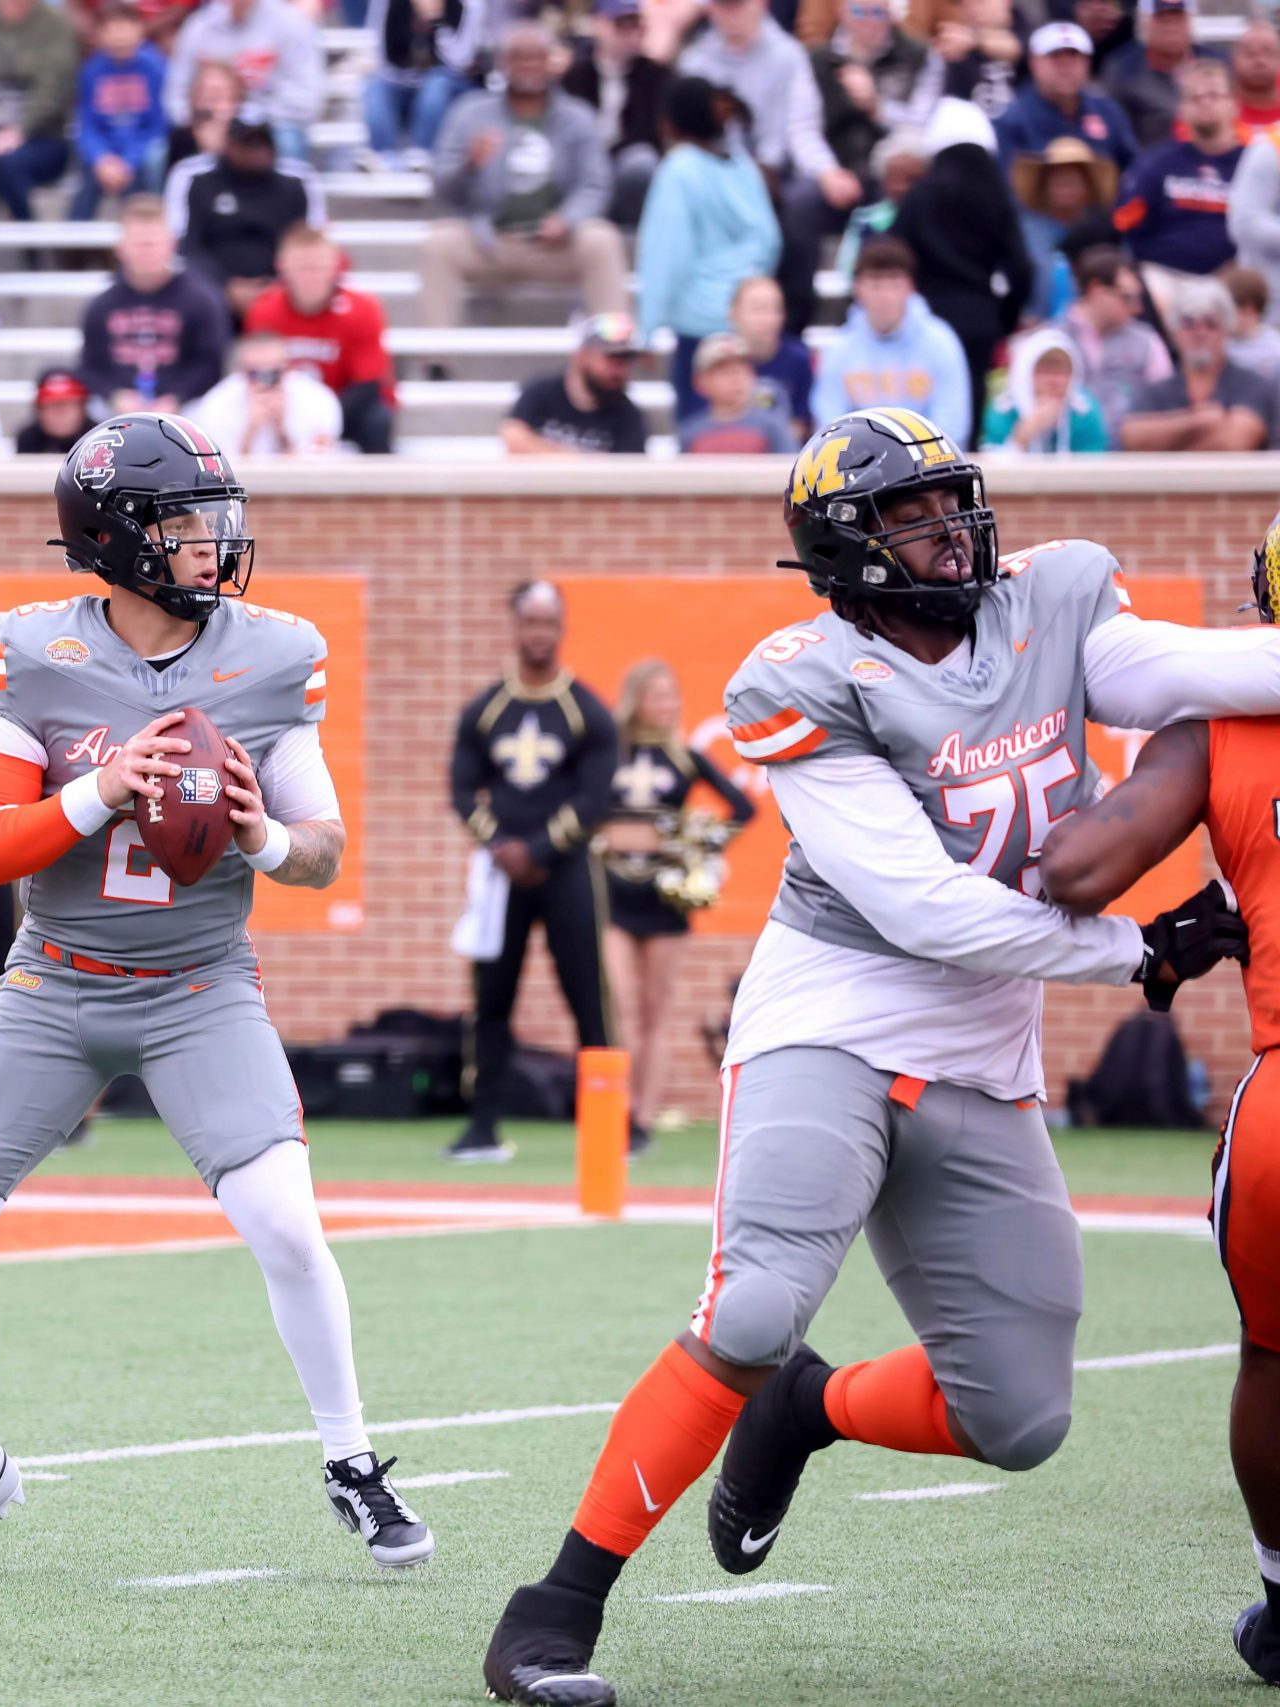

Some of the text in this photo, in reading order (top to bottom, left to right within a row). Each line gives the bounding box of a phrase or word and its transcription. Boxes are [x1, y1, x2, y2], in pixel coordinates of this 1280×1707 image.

[790, 435, 852, 510] M
[927, 706, 1069, 779] American
[197, 773, 215, 801] NFL
[939, 743, 1082, 900] 75
[99, 802, 175, 907] 2
